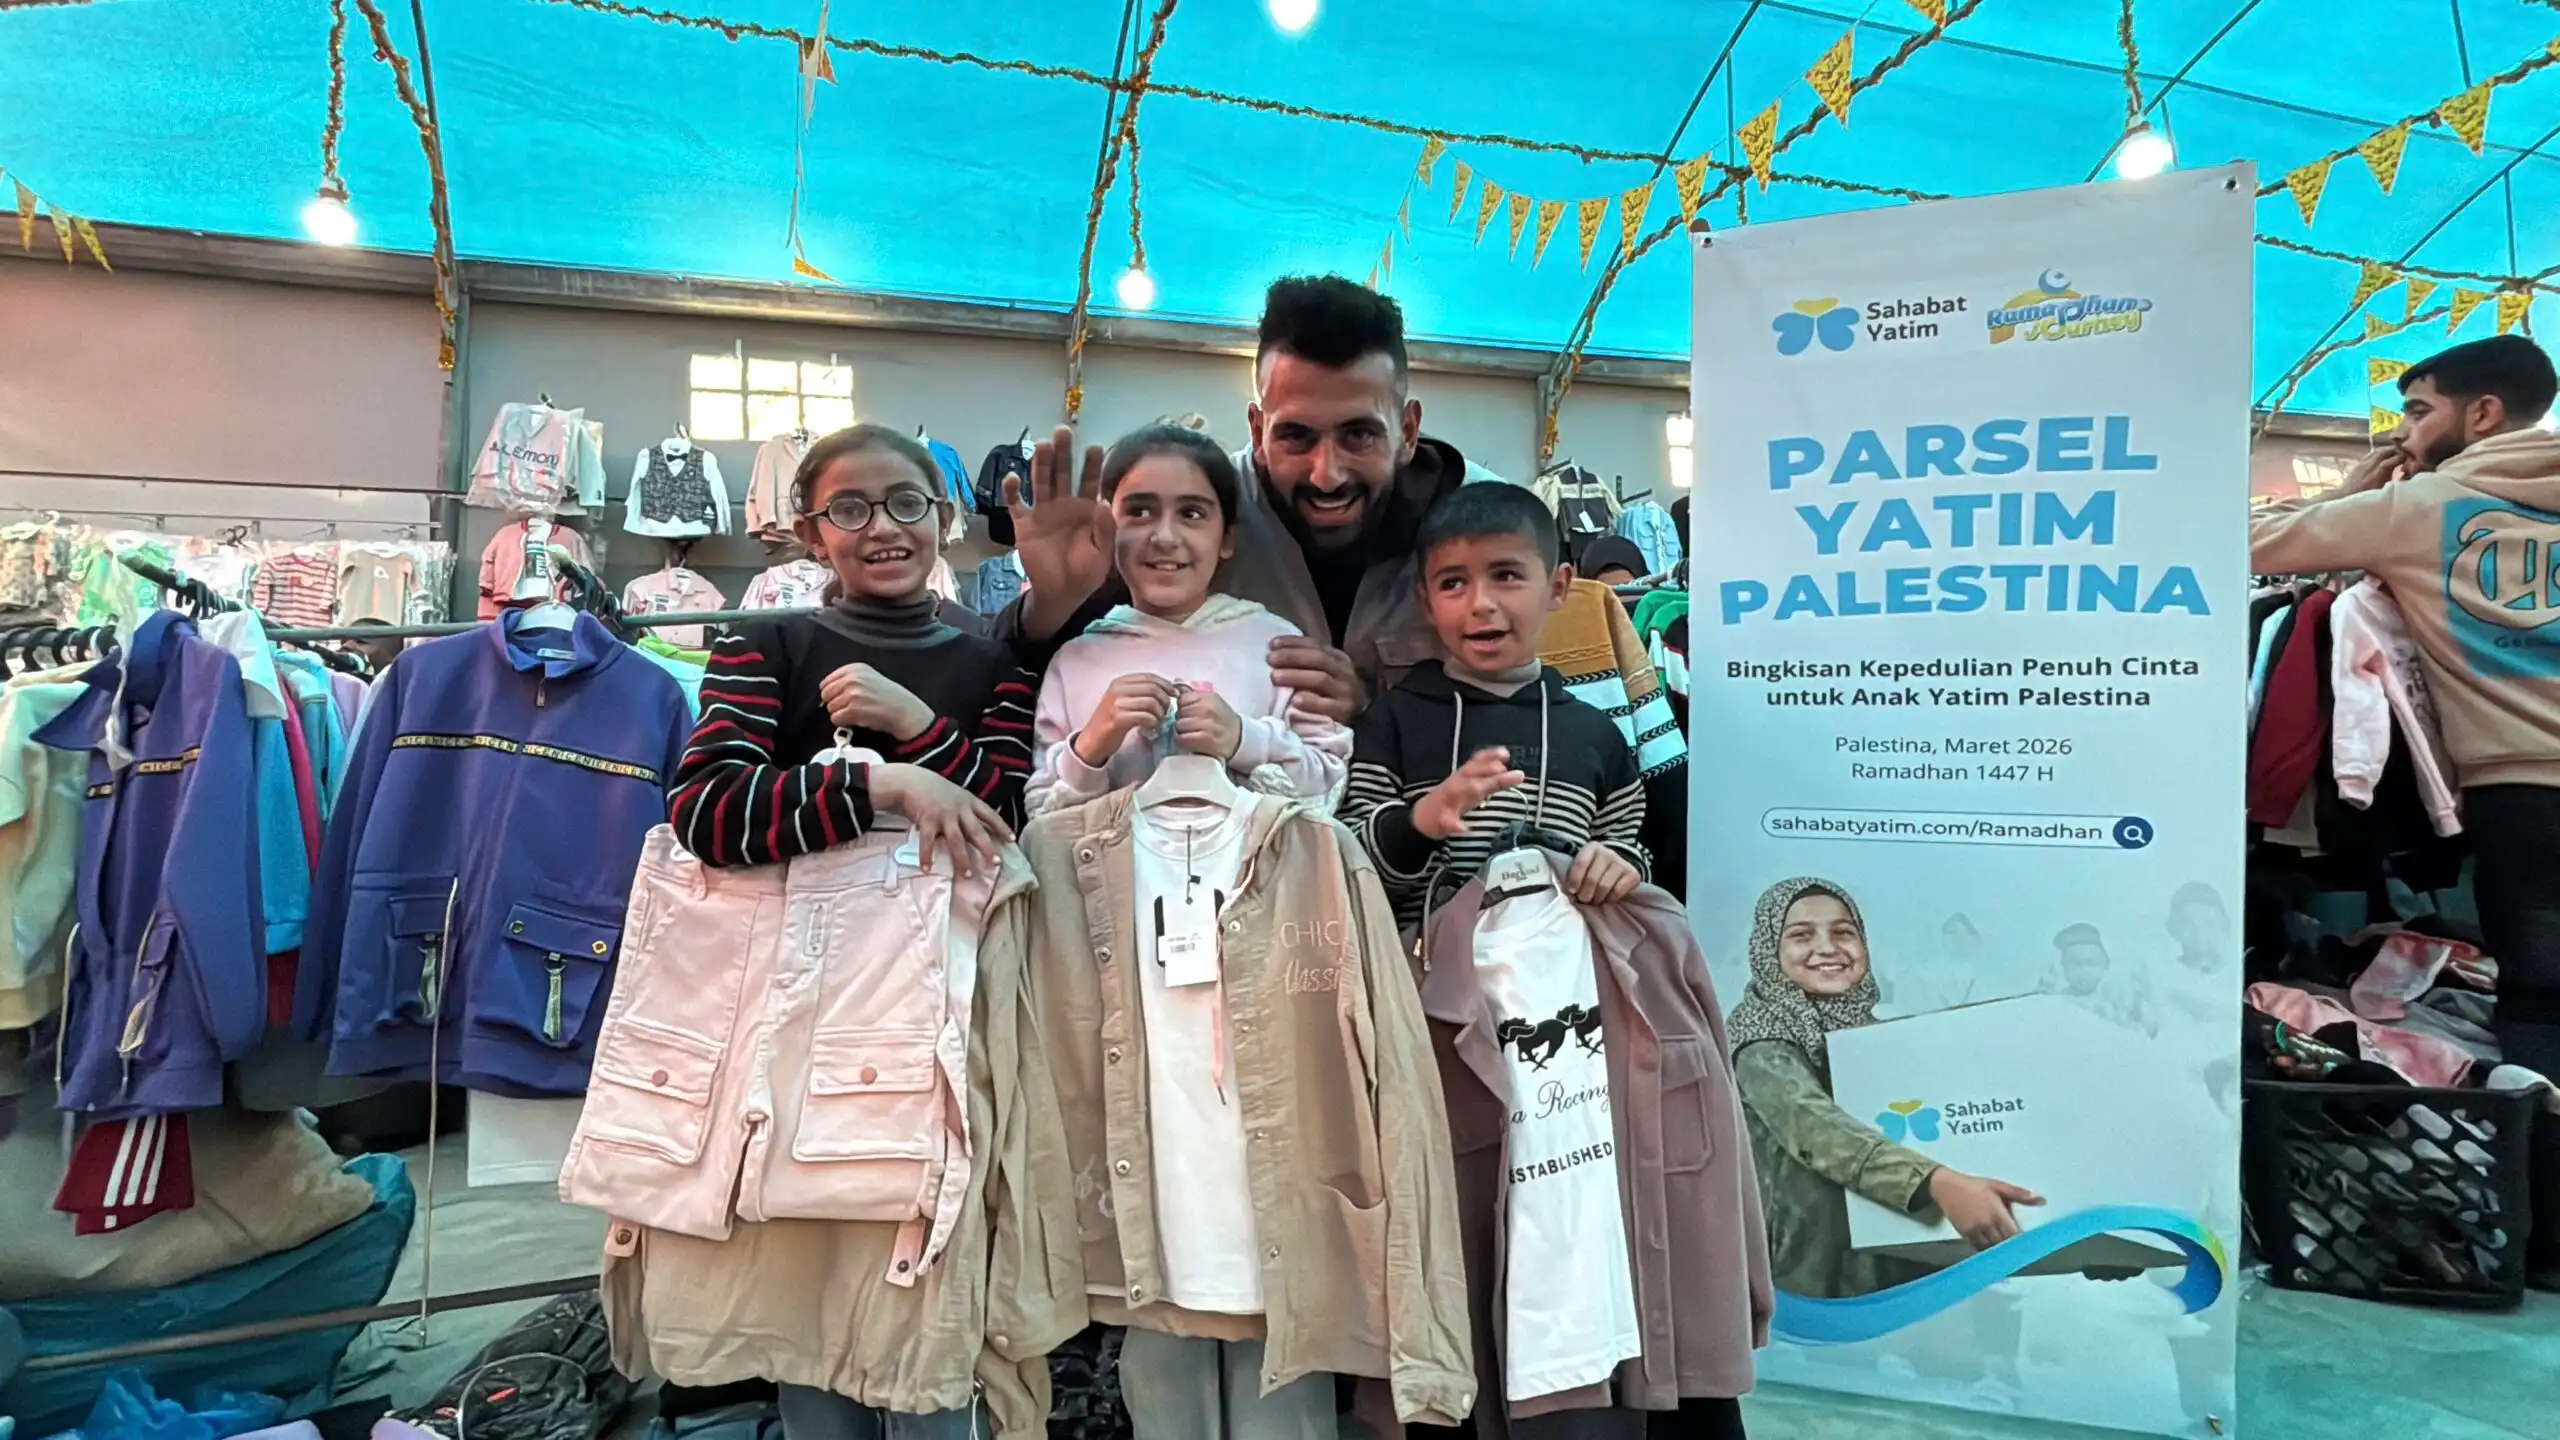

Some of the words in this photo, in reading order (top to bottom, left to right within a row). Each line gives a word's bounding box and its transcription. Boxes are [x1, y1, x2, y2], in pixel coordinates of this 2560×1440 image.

[1866, 295, 1968, 320] Sahabat
[1866, 321, 1939, 342] Yatim
[1768, 416, 2158, 490] PARSEL
[1794, 490, 2117, 555] YATIM
[1720, 564, 2211, 625] PALESTINA
[1726, 659, 1851, 682] Bingkisan
[1860, 658, 2013, 682] Kepedulian
[2022, 656, 2113, 677] Penuh
[2122, 656, 2200, 676] Cinta
[1767, 688, 1844, 706] untuk
[1852, 688, 1920, 706] Anak
[1928, 687, 2010, 706] Yatim
[2018, 687, 2151, 707] Palestina
[1835, 736, 1938, 756] Palestina,
[1945, 737, 2011, 755] Maret
[2017, 737, 2073, 755] 2026
[1851, 763, 1968, 781] Ramadhan
[1977, 765, 2029, 781] 1447
[2037, 765, 2054, 781] H
[1771, 815, 2103, 840] sahabatyatim.com/Ramadhan
[1944, 1098, 2025, 1118] Sahabat
[1946, 1118, 2004, 1136] Yatim
